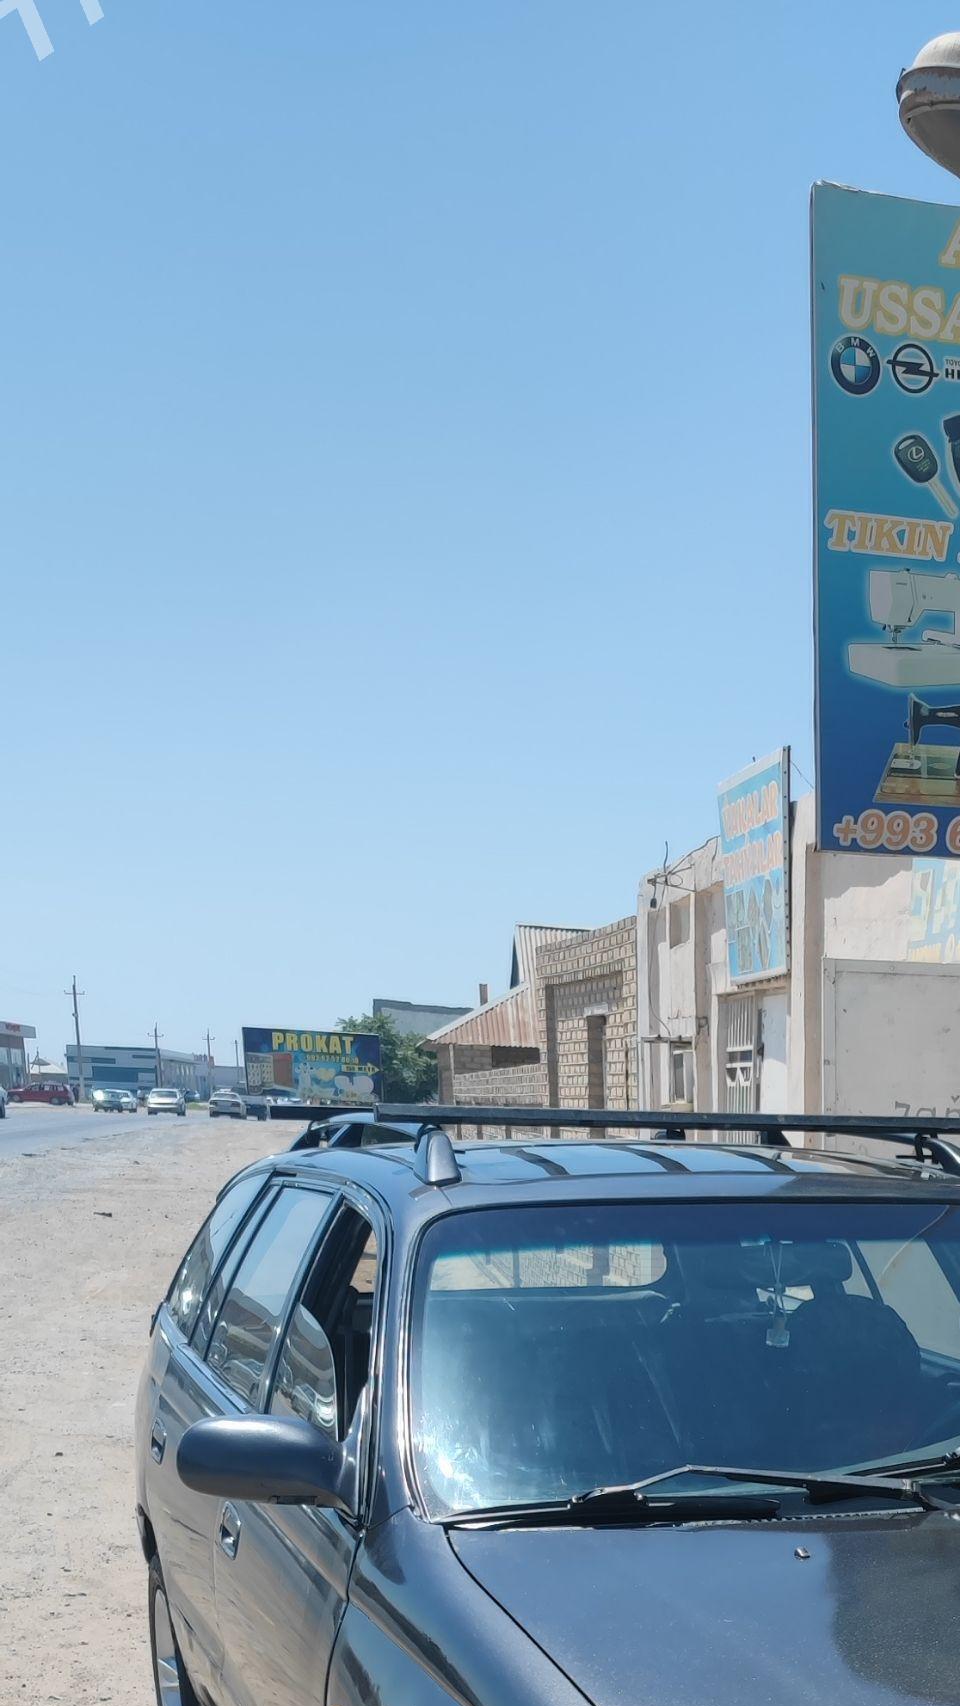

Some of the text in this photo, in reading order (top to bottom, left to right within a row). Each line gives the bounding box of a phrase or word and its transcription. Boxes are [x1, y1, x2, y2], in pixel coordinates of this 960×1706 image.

[836, 337, 876, 358] BMW
[825, 511, 952, 560] TIKIN
[835, 810, 936, 849] +993
[272, 1032, 354, 1054] PROKAT
